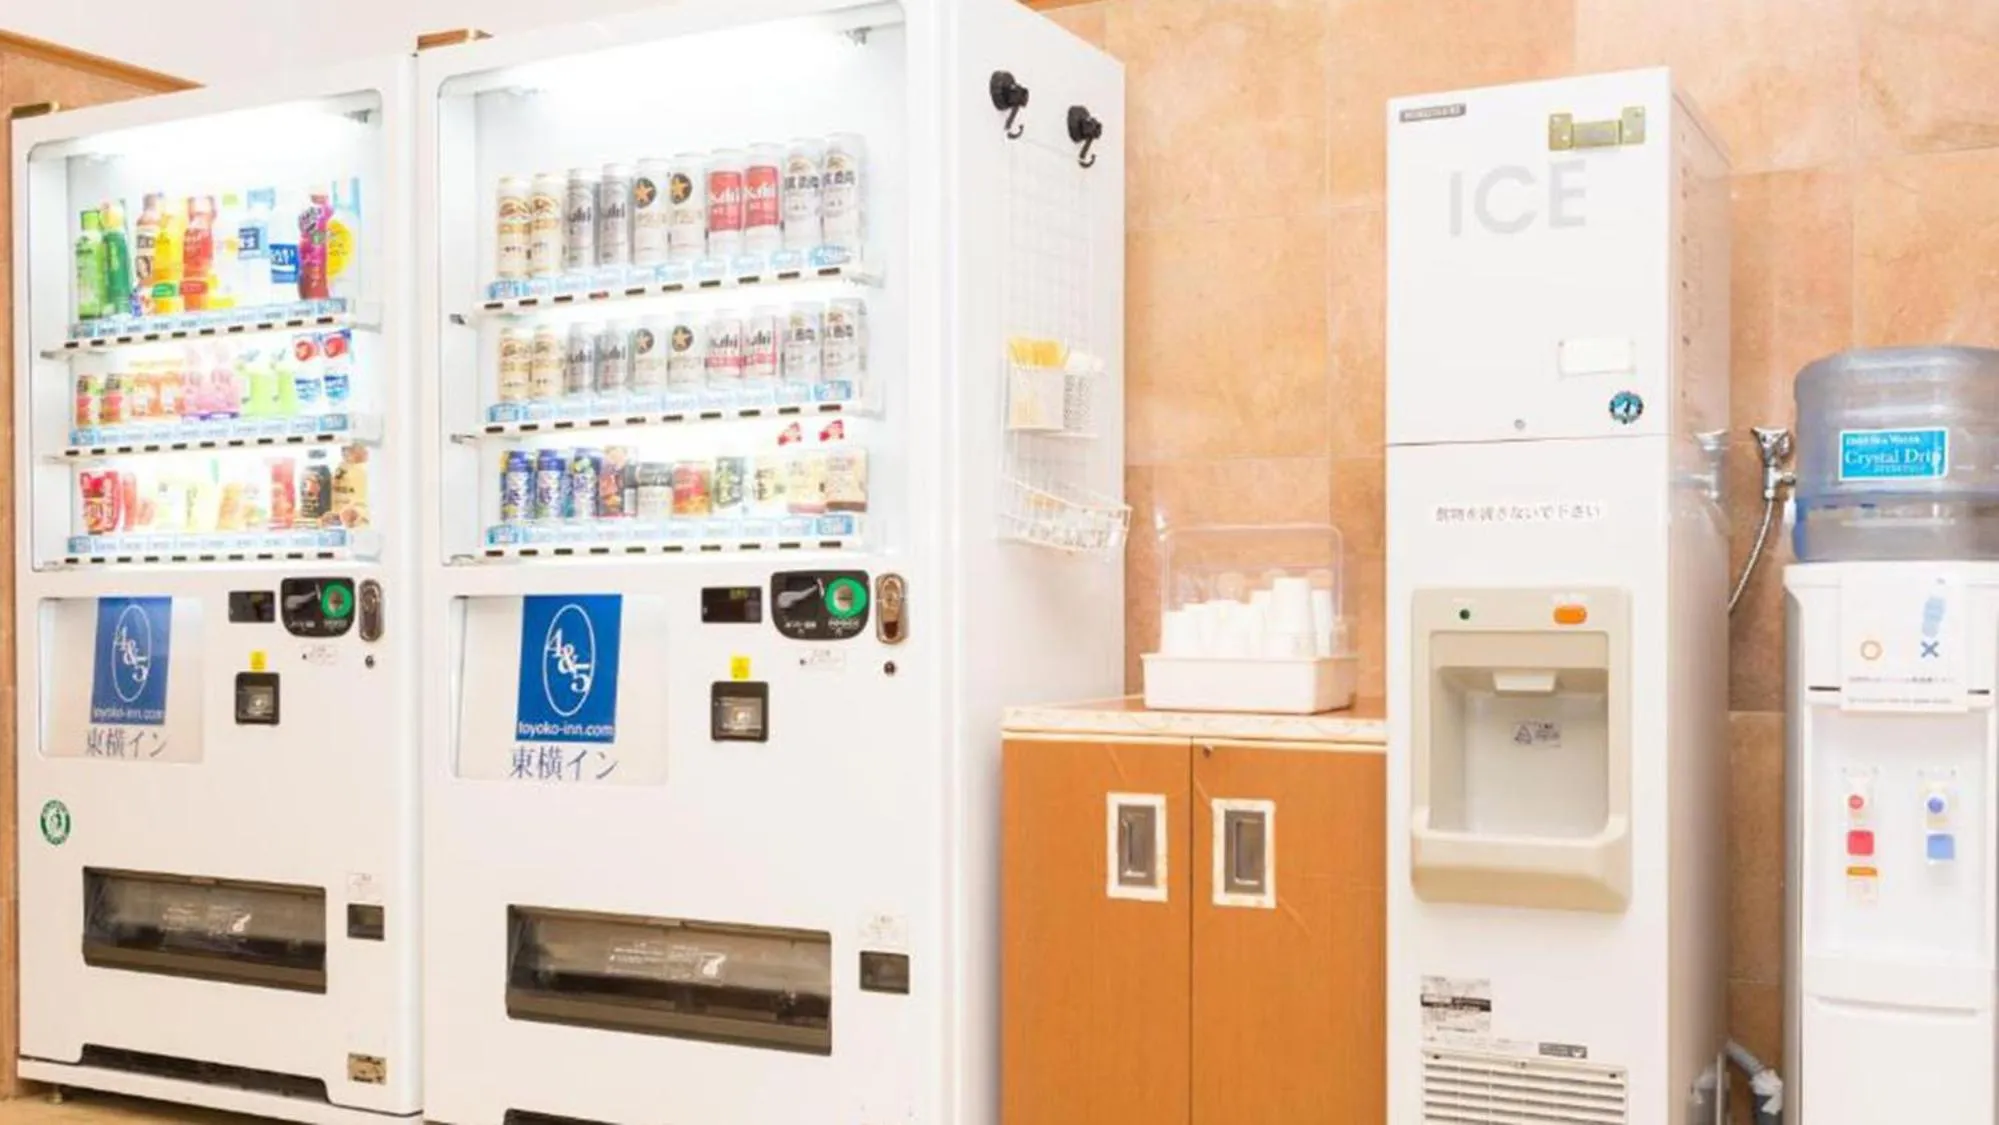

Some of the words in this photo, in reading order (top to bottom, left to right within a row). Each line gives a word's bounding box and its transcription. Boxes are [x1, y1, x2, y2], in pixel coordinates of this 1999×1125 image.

[1449, 158, 1584, 240] ICE
[1845, 449, 1899, 470] Crystal
[546, 627, 592, 693] 4&5
[86, 726, 168, 760] 東横イン
[518, 720, 614, 737] toyoko-inn.com
[509, 744, 619, 782] 東横イン
